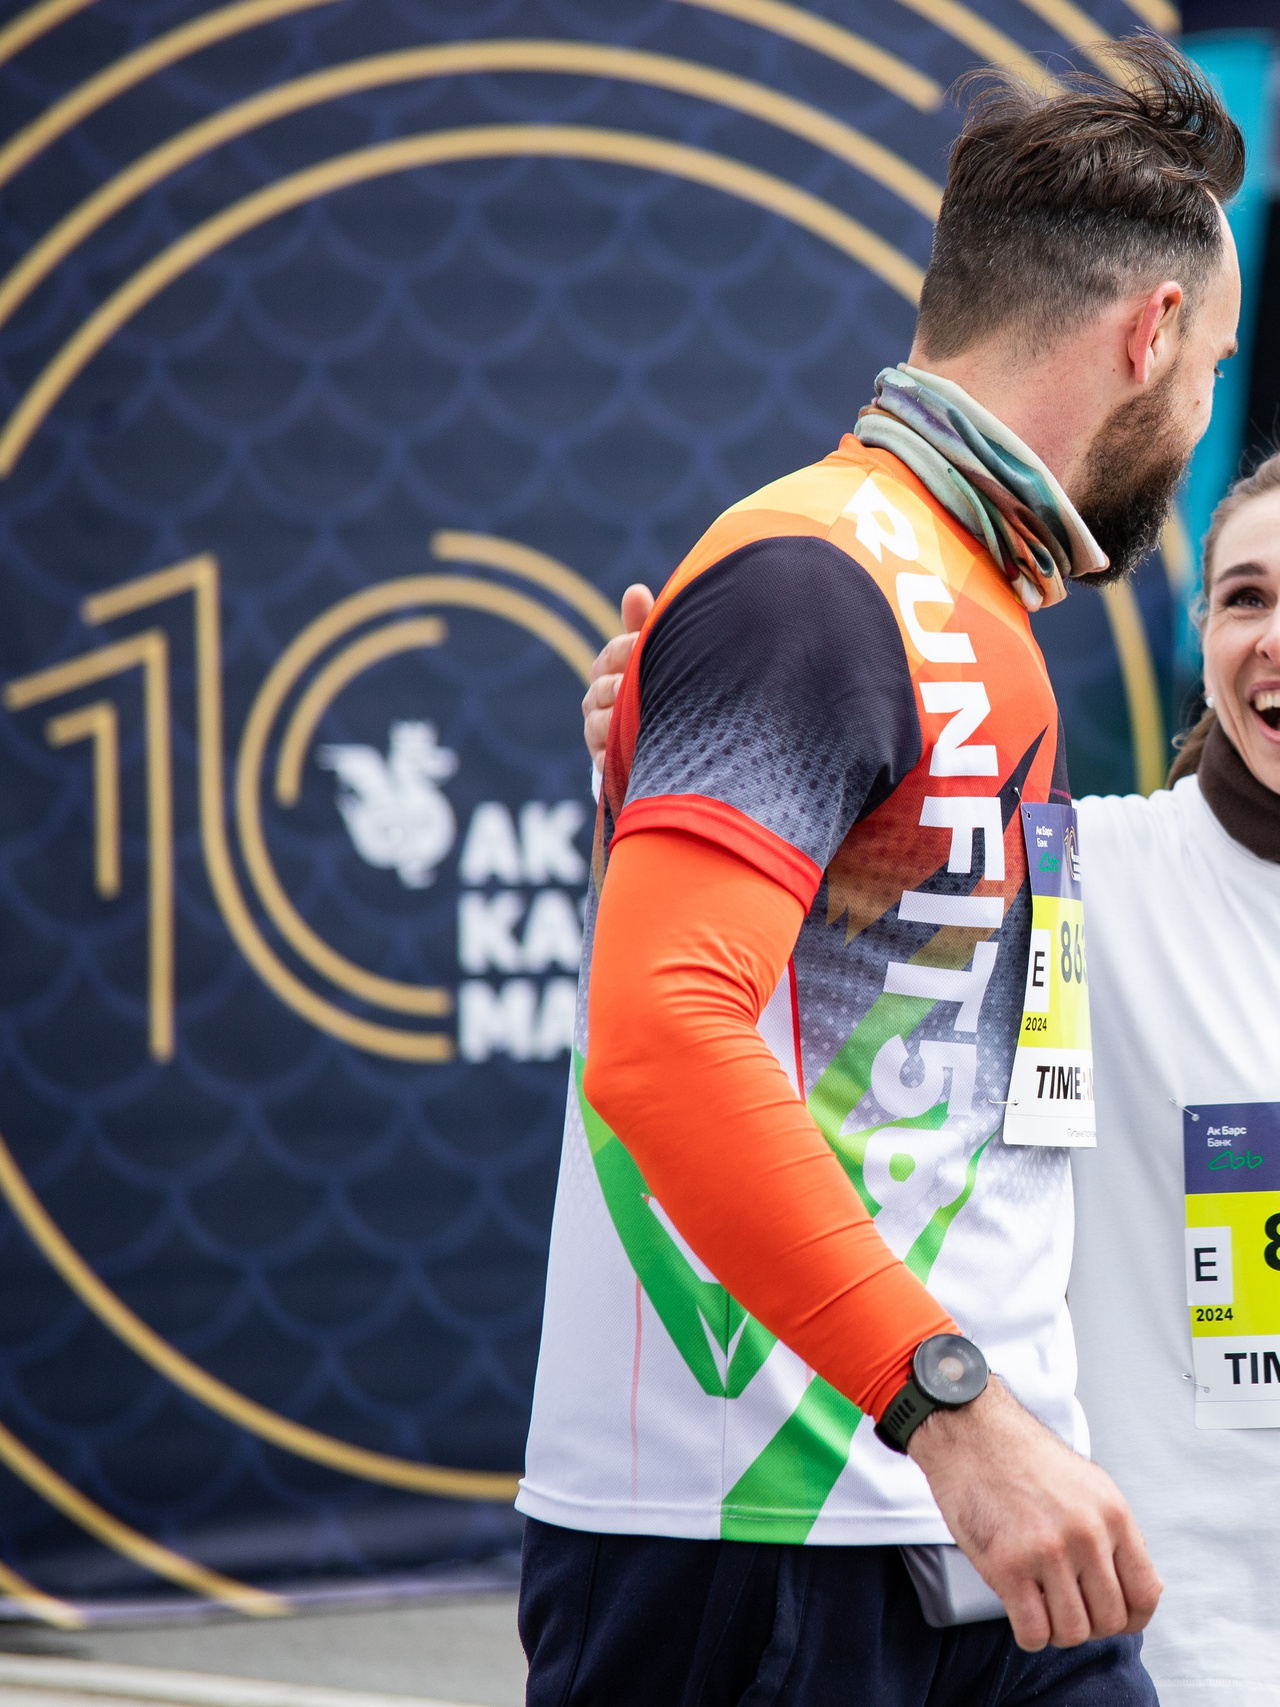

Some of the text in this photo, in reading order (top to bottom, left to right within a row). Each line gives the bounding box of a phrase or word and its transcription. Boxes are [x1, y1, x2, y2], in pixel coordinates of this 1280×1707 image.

[459, 800, 588, 887] АК
[457, 887, 588, 979] КА
[1032, 951, 1045, 987] E
[1025, 1016, 1047, 1032] 2024
[1207, 1126, 1247, 1137] Ак Барс
[1207, 1138, 1232, 1148] Банк
[1194, 1247, 1218, 1282] E
[1196, 1307, 1234, 1322] 2024
